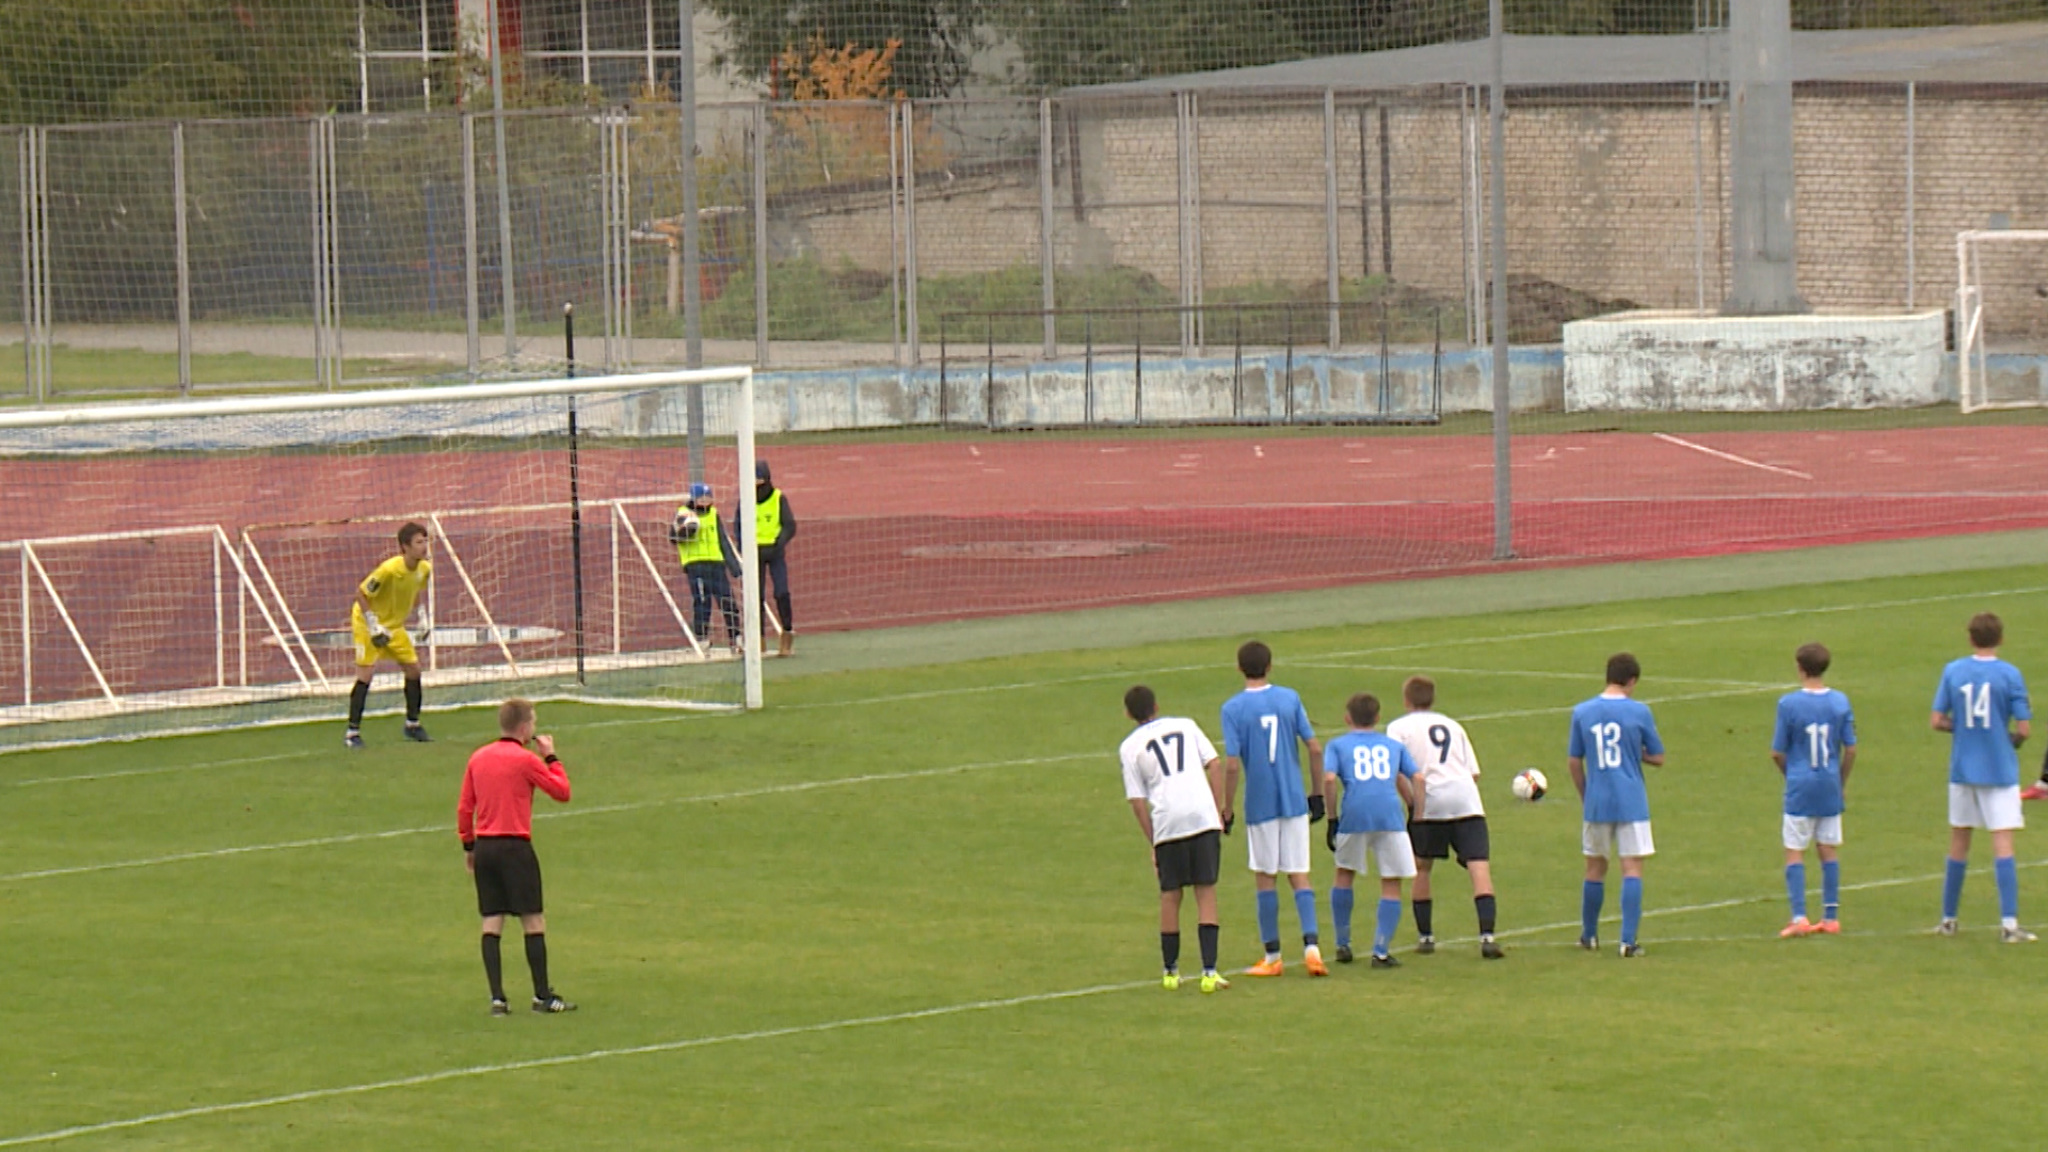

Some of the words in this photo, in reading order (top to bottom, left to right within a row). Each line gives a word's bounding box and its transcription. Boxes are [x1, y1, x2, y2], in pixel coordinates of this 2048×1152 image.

[1959, 682, 1991, 729] 14
[1145, 731, 1185, 777] 17
[1260, 713, 1279, 763] 7
[1428, 724, 1451, 764] 9
[1590, 721, 1622, 770] 13
[1805, 722, 1829, 768] 11
[1353, 744, 1391, 782] 88
